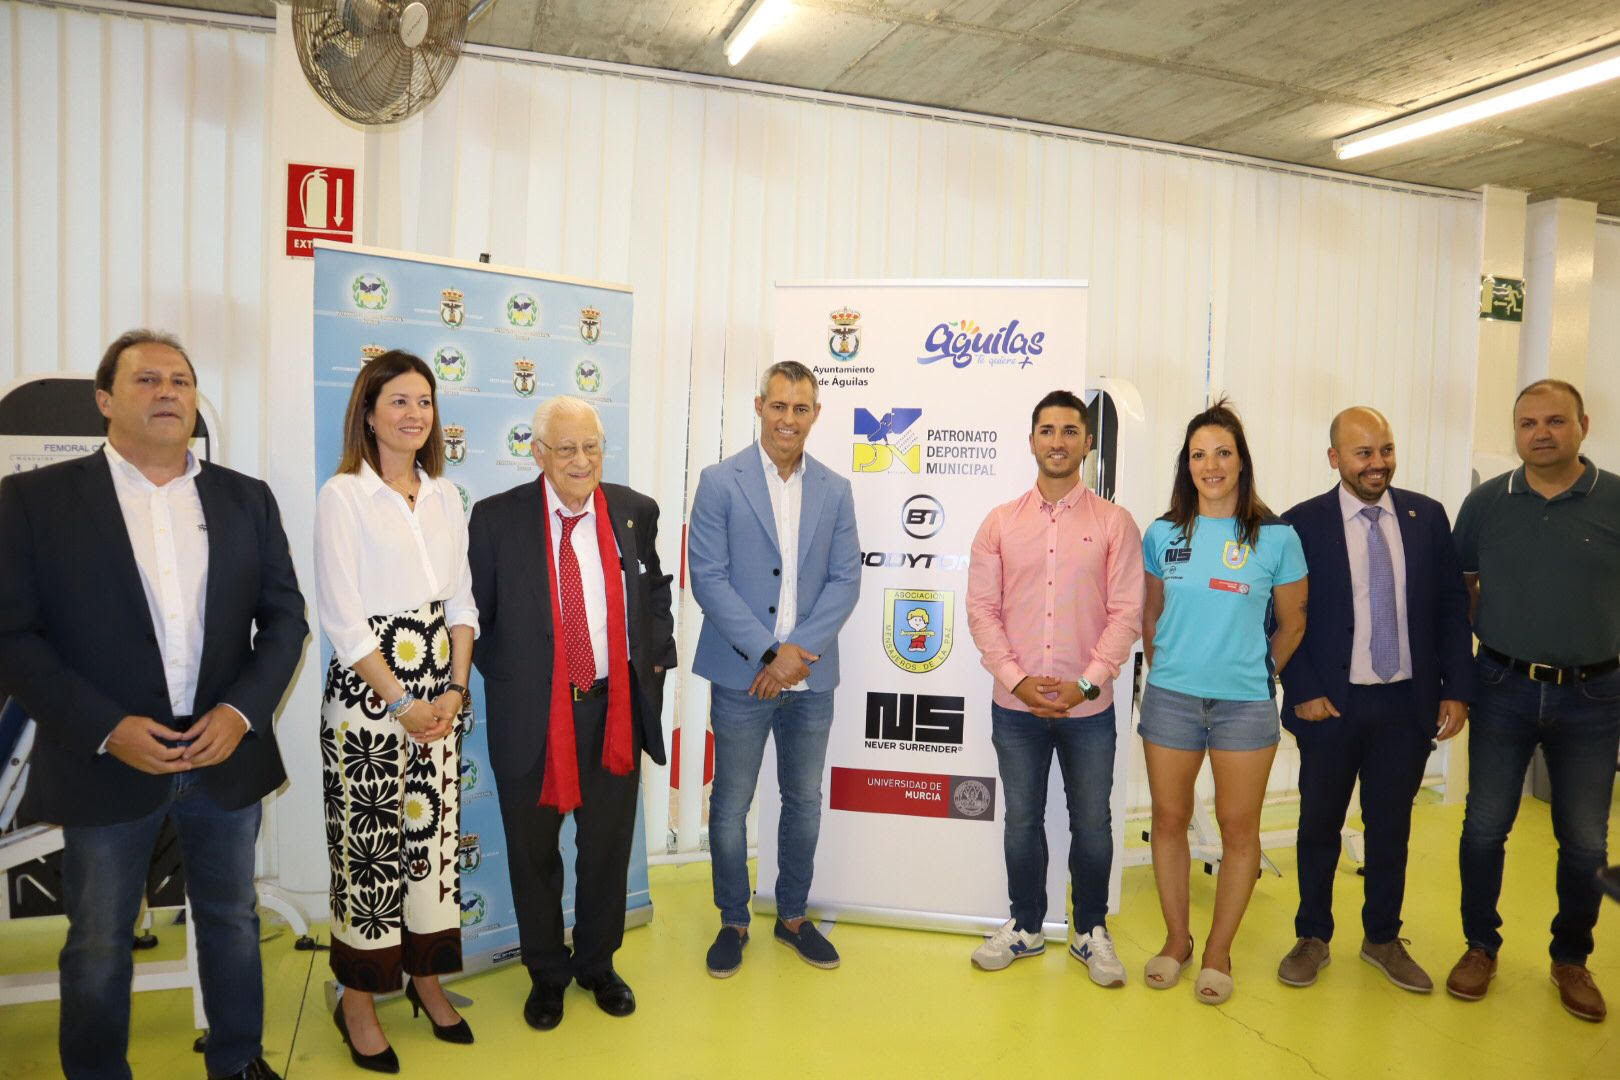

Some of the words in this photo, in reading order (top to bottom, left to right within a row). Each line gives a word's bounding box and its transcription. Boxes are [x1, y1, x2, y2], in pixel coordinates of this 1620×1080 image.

[812, 365, 875, 375] Ayuntamiento
[818, 377, 830, 386] de
[831, 375, 869, 389] Águilas
[927, 429, 998, 443] PATRONATO
[43, 444, 89, 452] FEMORAL
[926, 446, 998, 460] DEPORTIVO
[926, 462, 997, 477] MUNICIPAL
[905, 509, 940, 525] BT
[923, 661, 936, 671] DE
[938, 649, 949, 661] LA
[865, 691, 965, 745] NS
[864, 740, 897, 750] NEVER
[867, 777, 928, 790] UNIVERSIDAD
[929, 781, 942, 791] DE
[904, 790, 942, 801] MURCIA
